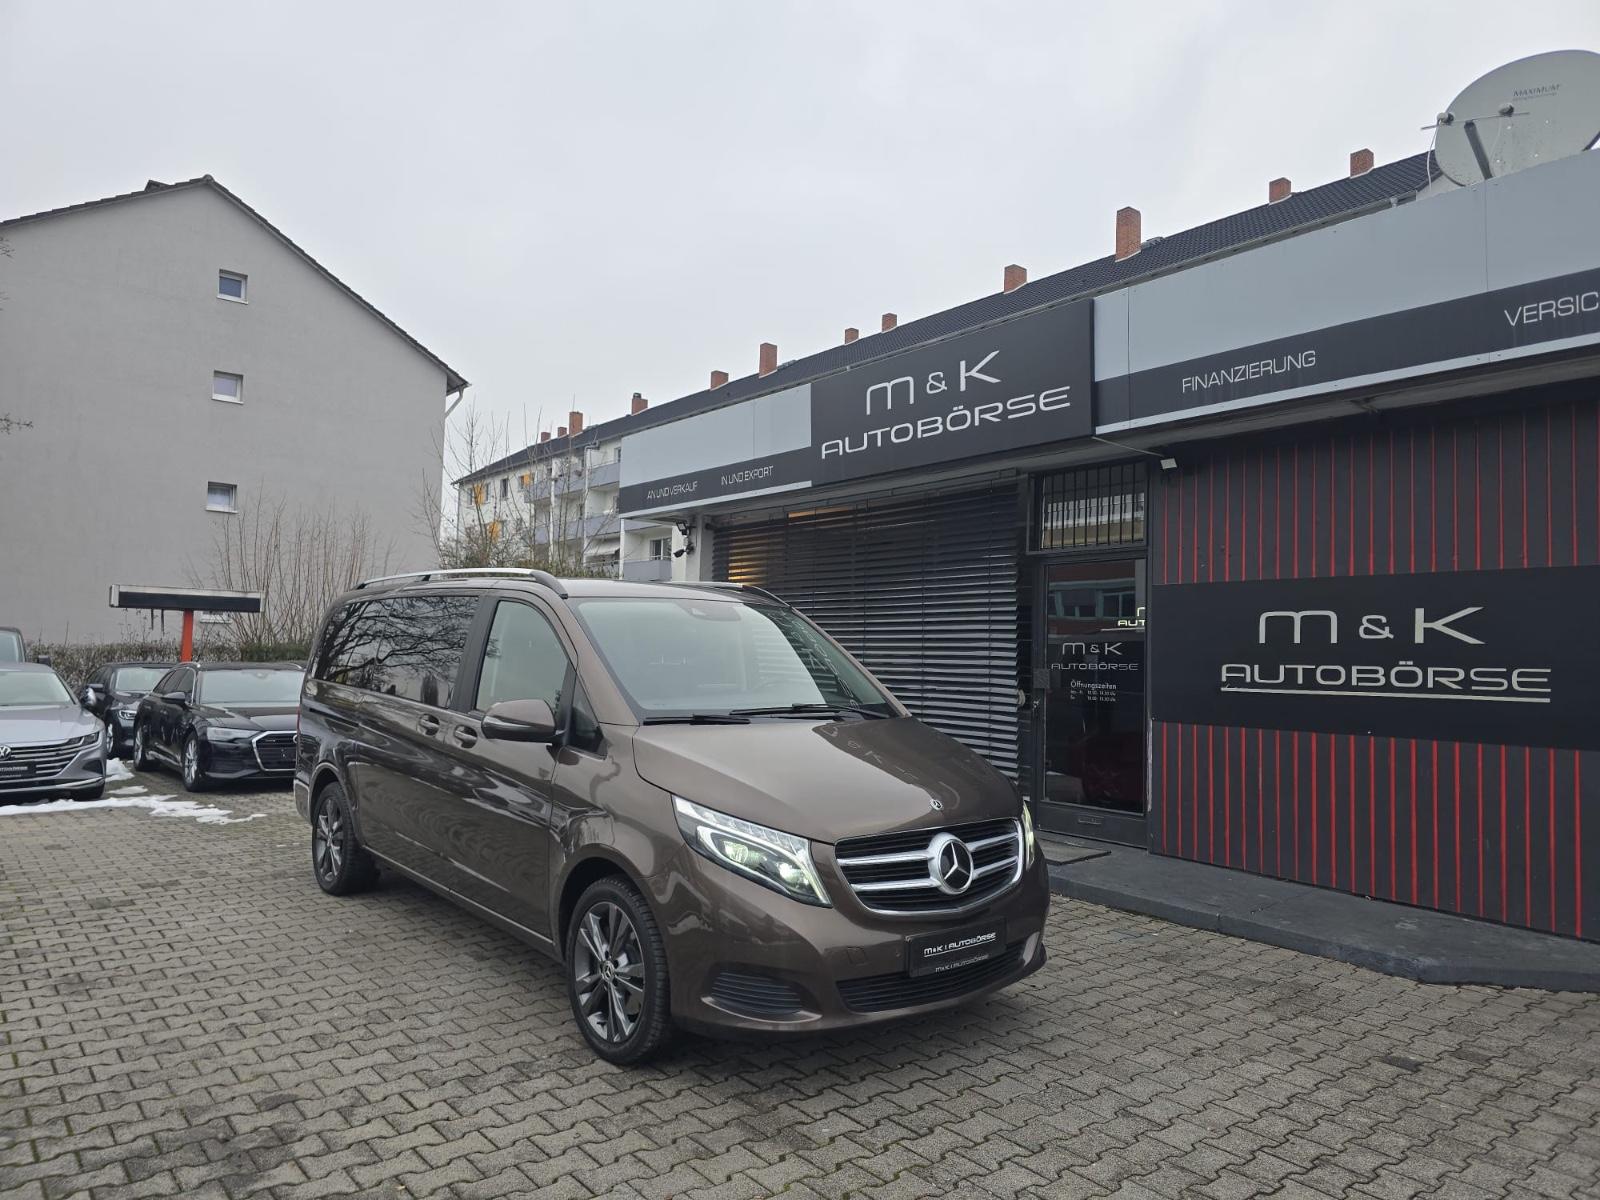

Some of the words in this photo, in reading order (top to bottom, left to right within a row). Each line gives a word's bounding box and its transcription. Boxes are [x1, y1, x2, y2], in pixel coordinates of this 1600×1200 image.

[866, 376, 915, 415] M
[926, 371, 948, 394] &
[959, 350, 1002, 392] K
[1182, 350, 1316, 393] FINANZIERUNG
[821, 385, 1071, 460] AUTOBÖRSE
[728, 472, 744, 484] UND
[744, 465, 774, 481] EXPORT
[647, 490, 656, 499] AN
[656, 487, 670, 499] UND
[670, 481, 698, 495] VERKAUF
[1258, 610, 1338, 644] M
[1358, 614, 1394, 639] &
[1414, 606, 1486, 645] K
[1062, 642, 1086, 655] M
[1090, 644, 1100, 653] &
[1104, 642, 1123, 655] K
[1051, 662, 1139, 671] AUTOBÖRSE
[1221, 660, 1551, 692] AUTOBÖRSE
[948, 932, 996, 950] AUTOBÖRSE
